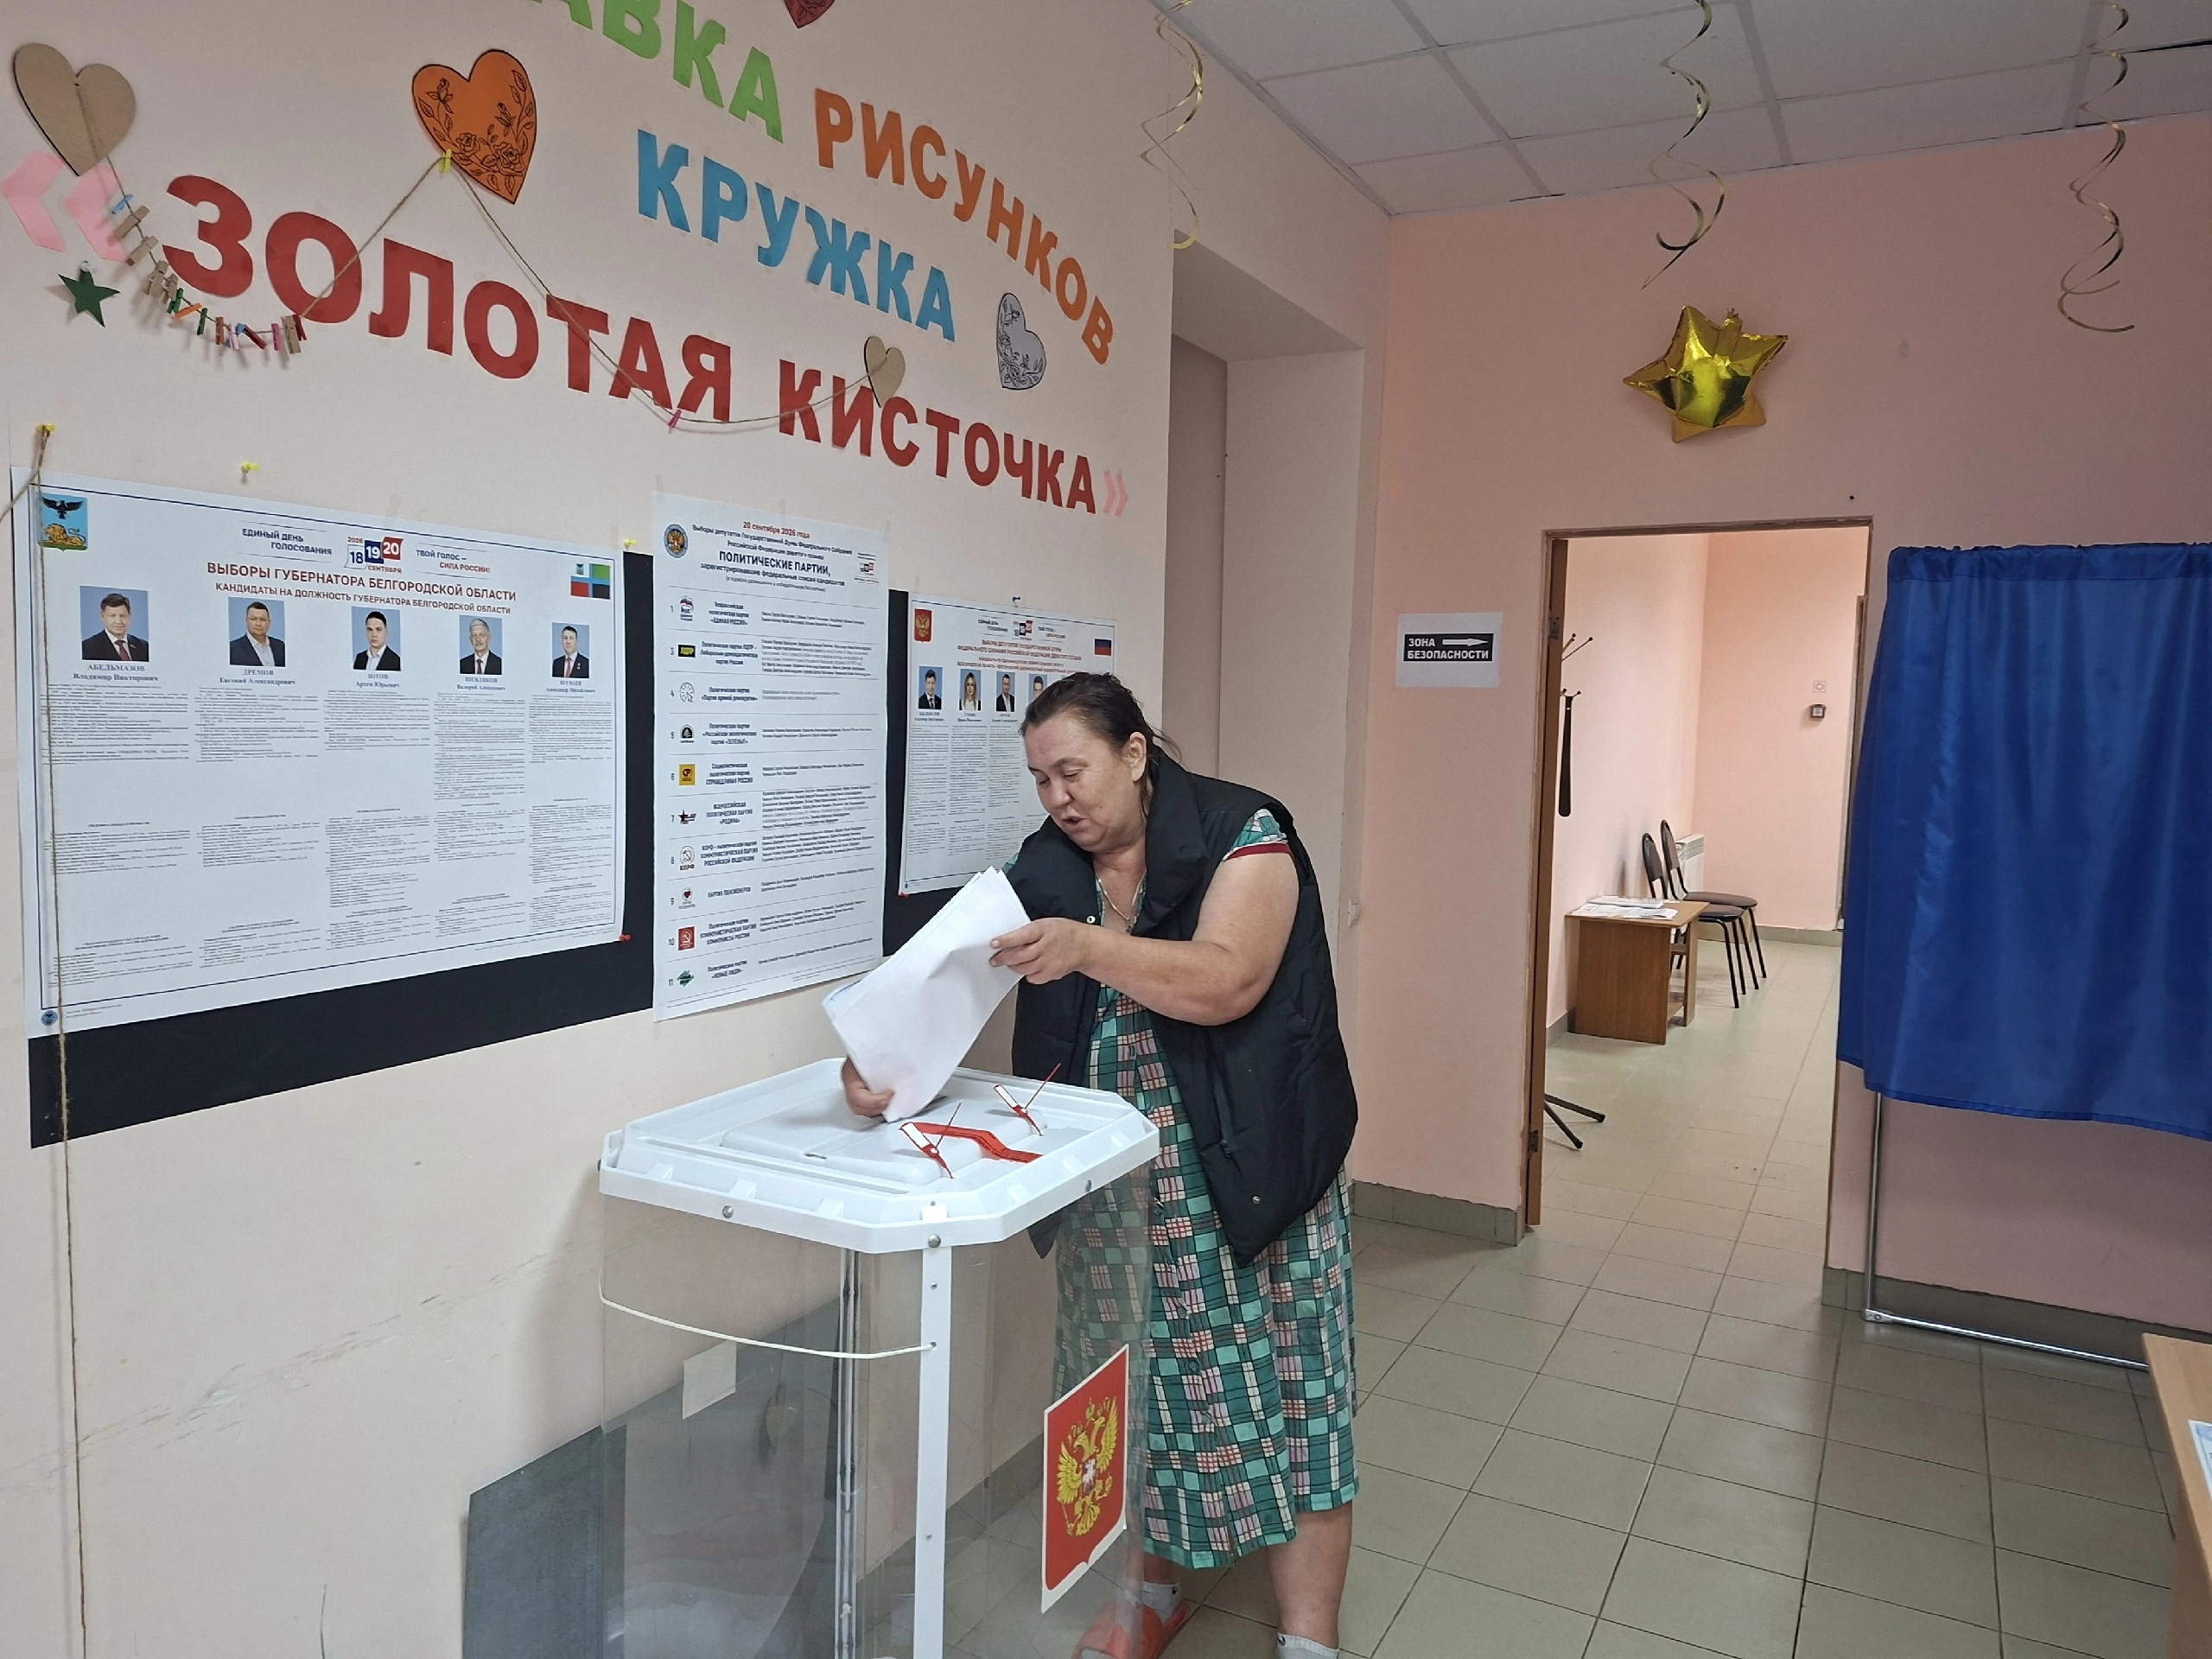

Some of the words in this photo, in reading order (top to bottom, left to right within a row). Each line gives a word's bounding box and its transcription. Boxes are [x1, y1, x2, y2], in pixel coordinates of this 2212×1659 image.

[815, 88, 1114, 365] РИСУНКОВ
[638, 129, 955, 342] КРУЖКА
[242, 528, 280, 540] ЕДИНЫЙ
[281, 533, 304, 543] ДЕНЬ
[752, 524, 780, 534] сентября
[781, 527, 796, 537] 2026
[270, 542, 333, 556] ГОЛОСОВАНИЯ
[349, 550, 364, 564] 18
[365, 545, 381, 560] 19
[383, 542, 400, 556] 20
[367, 564, 403, 575] СЕНТЯБРЯ
[439, 562, 459, 570] СИЛА
[460, 563, 491, 573] РОССИИ!
[719, 550, 792, 570] ПОЛИТИЧЕСКИЕ
[795, 562, 830, 577] ПАРТИИ,
[207, 562, 270, 579] ВЫБОРЫ
[275, 569, 365, 587] ГУБЕРНАТОРА
[369, 577, 463, 596] БЕЛГОРОДСКОЙ
[466, 587, 516, 601] ОБЛАСТИ
[216, 582, 277, 595] КАНДИДАТЫ
[295, 589, 352, 601] ДОЛЖНОСТЬ
[353, 594, 411, 607] ГУБЕРНАТОРА
[412, 600, 474, 611] БЕЛГОРОДСКОЙ
[476, 605, 512, 614] ОБЛАСТИ
[1408, 638, 1435, 647] ЗОНА
[1407, 650, 1489, 659] БЕЗОПАСНОСТИ
[73, 673, 111, 682] Владимир
